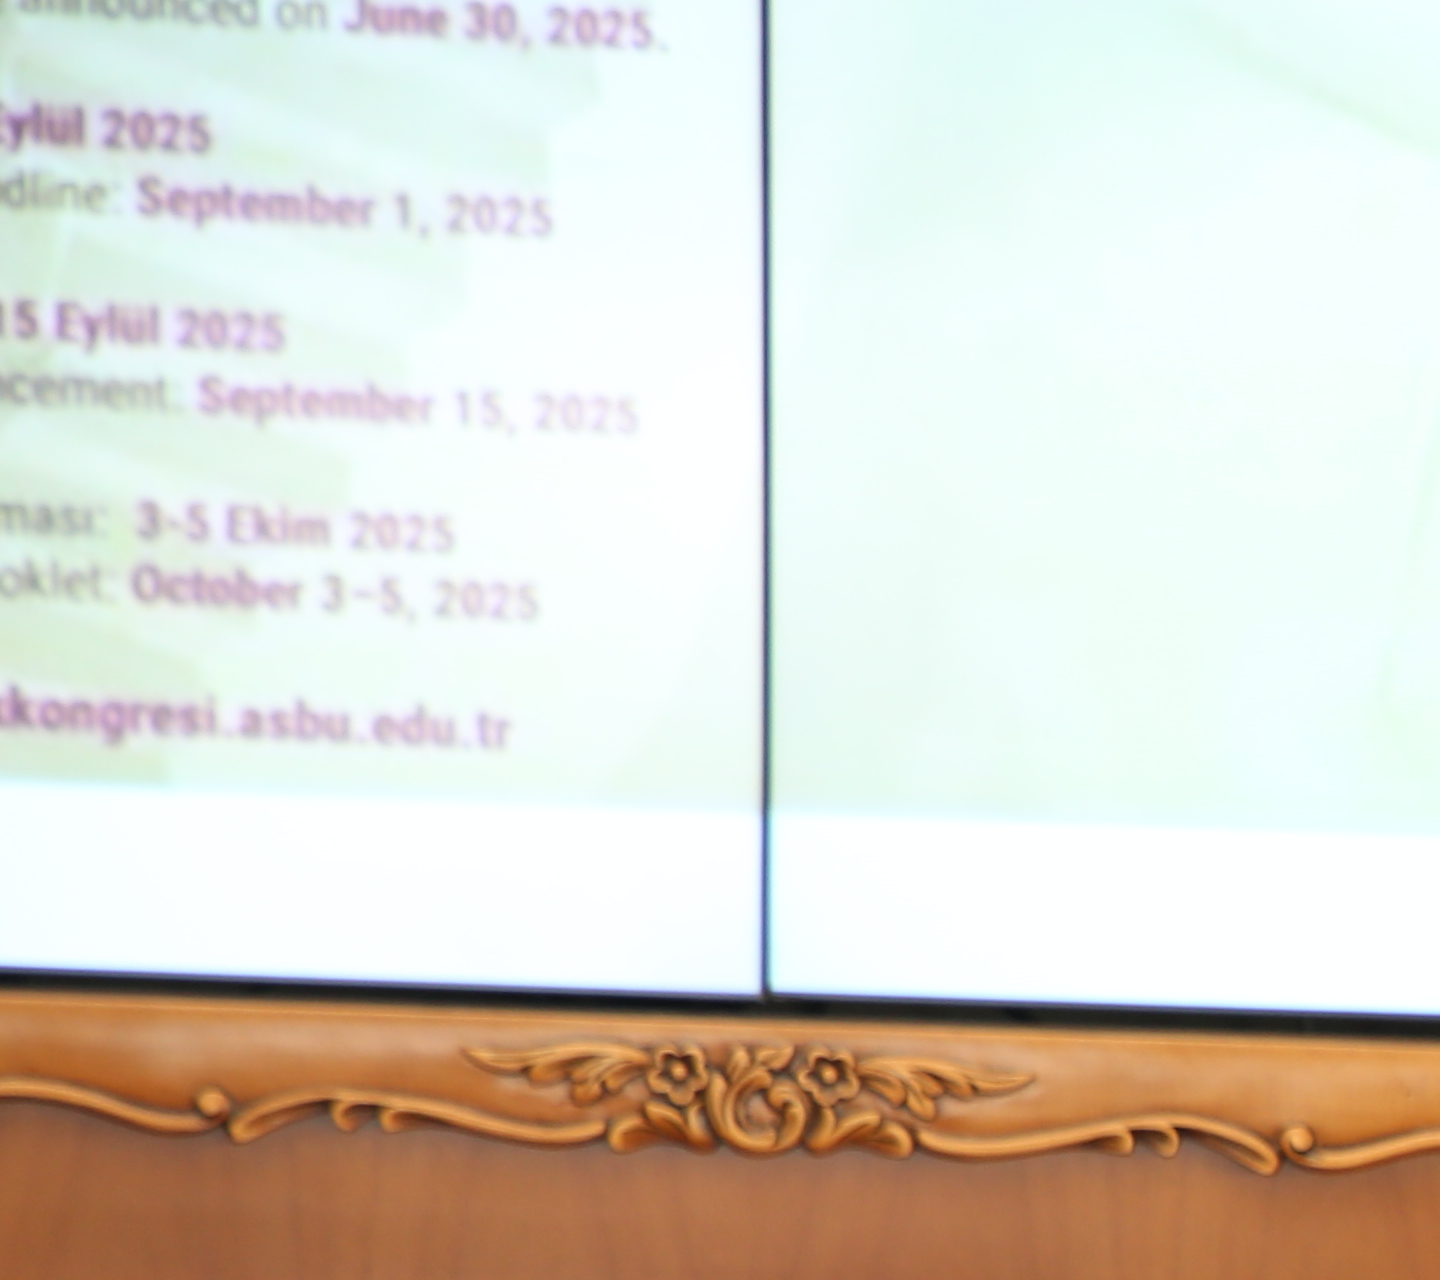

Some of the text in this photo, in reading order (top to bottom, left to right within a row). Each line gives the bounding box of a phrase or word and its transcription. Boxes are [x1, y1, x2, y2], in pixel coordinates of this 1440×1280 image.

[275, 2, 328, 31] on
[345, 0, 450, 38] June
[465, 2, 531, 50] 30,
[0, 99, 214, 154] ylül 2025
[136, 174, 375, 232] September
[446, 194, 554, 238] 2025
[174, 306, 287, 354] 2025
[196, 374, 434, 428] September
[533, 392, 640, 436] 2025
[226, 503, 331, 548] Ekim
[349, 512, 455, 553] 2025
[131, 562, 304, 608] October
[434, 579, 539, 621] 2025
